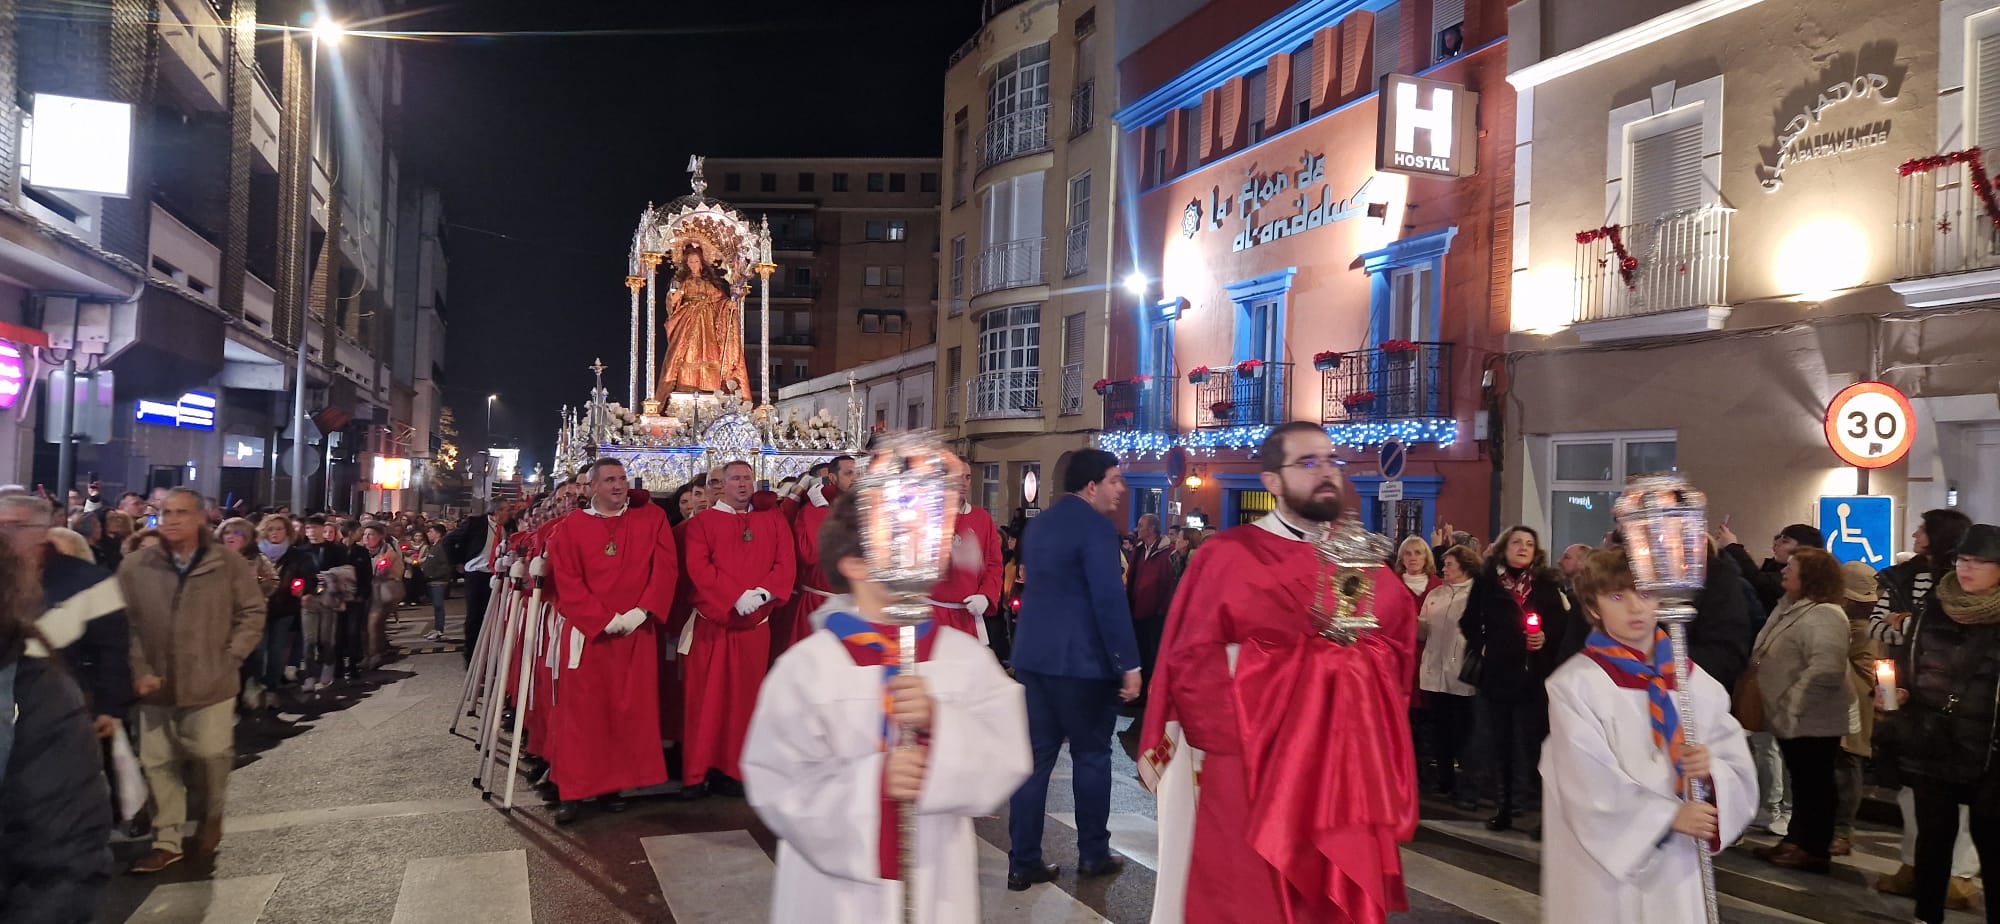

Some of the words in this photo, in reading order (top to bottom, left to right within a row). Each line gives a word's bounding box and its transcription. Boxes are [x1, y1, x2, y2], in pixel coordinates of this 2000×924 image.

[1395, 82, 1453, 158] H
[1761, 73, 1899, 193] GLADIADOR
[1394, 153, 1450, 172] HOSTAL
[1790, 131, 1888, 165] APARTAMENTOS
[1297, 152, 1328, 190] de
[1847, 411, 1897, 440] 30
